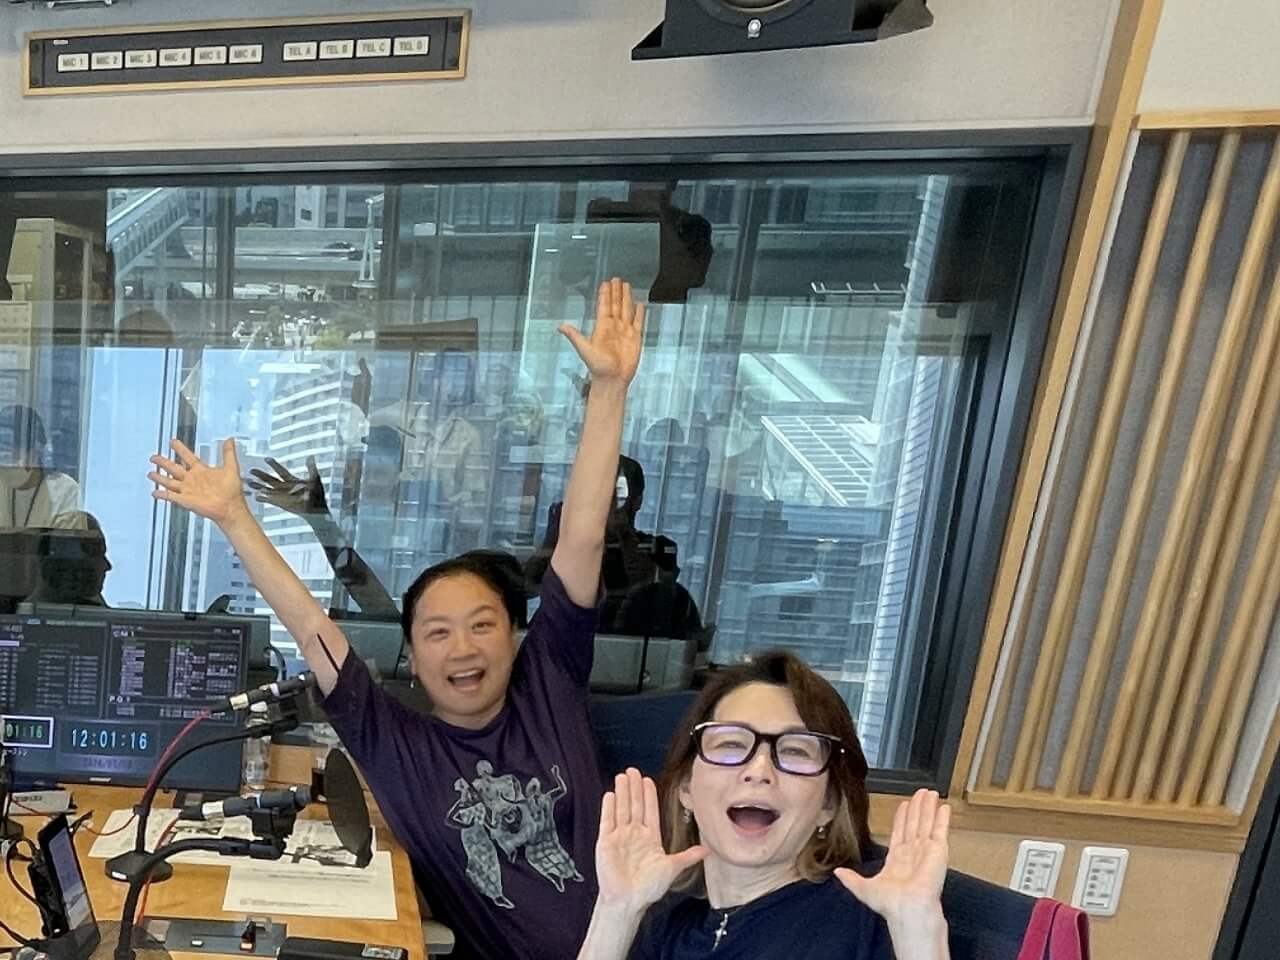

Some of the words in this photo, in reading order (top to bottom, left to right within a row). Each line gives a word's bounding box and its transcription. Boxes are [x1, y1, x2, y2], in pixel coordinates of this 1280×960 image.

[326, 45, 339, 54] TEL
[362, 43, 376, 52] TEL
[399, 41, 413, 51] TEL
[199, 51, 213, 60] MIC
[234, 49, 248, 58] MIC
[288, 47, 302, 56] TEL
[62, 58, 76, 66] MIC
[95, 56, 110, 64] MIC
[129, 55, 143, 63] MIC
[164, 53, 178, 62] MIC
[71, 728, 148, 749] 12:01:16
